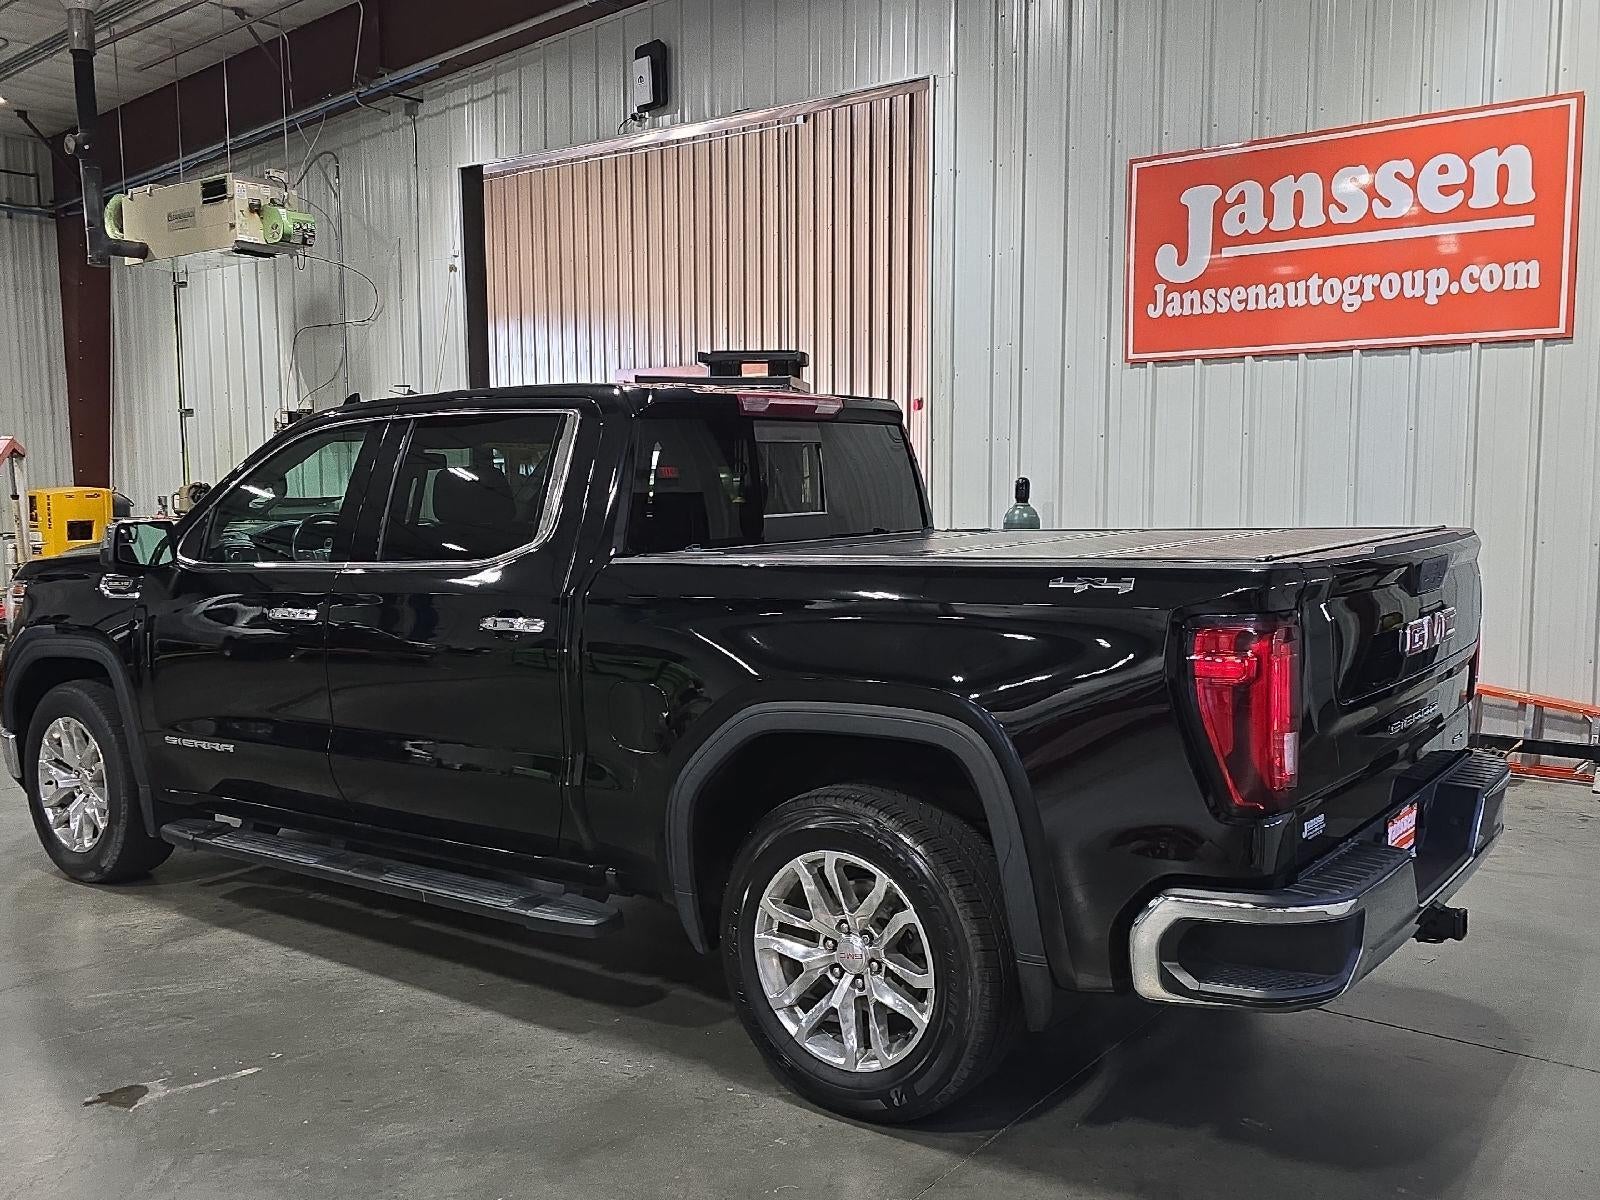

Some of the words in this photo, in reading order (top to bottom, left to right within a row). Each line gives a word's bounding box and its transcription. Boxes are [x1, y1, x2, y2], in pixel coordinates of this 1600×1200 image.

[1154, 144, 1536, 283] Janssen
[1147, 259, 1541, 318] Janssenautogroup.com
[1403, 606, 1457, 657] GMC
[164, 735, 235, 753] SIERRA
